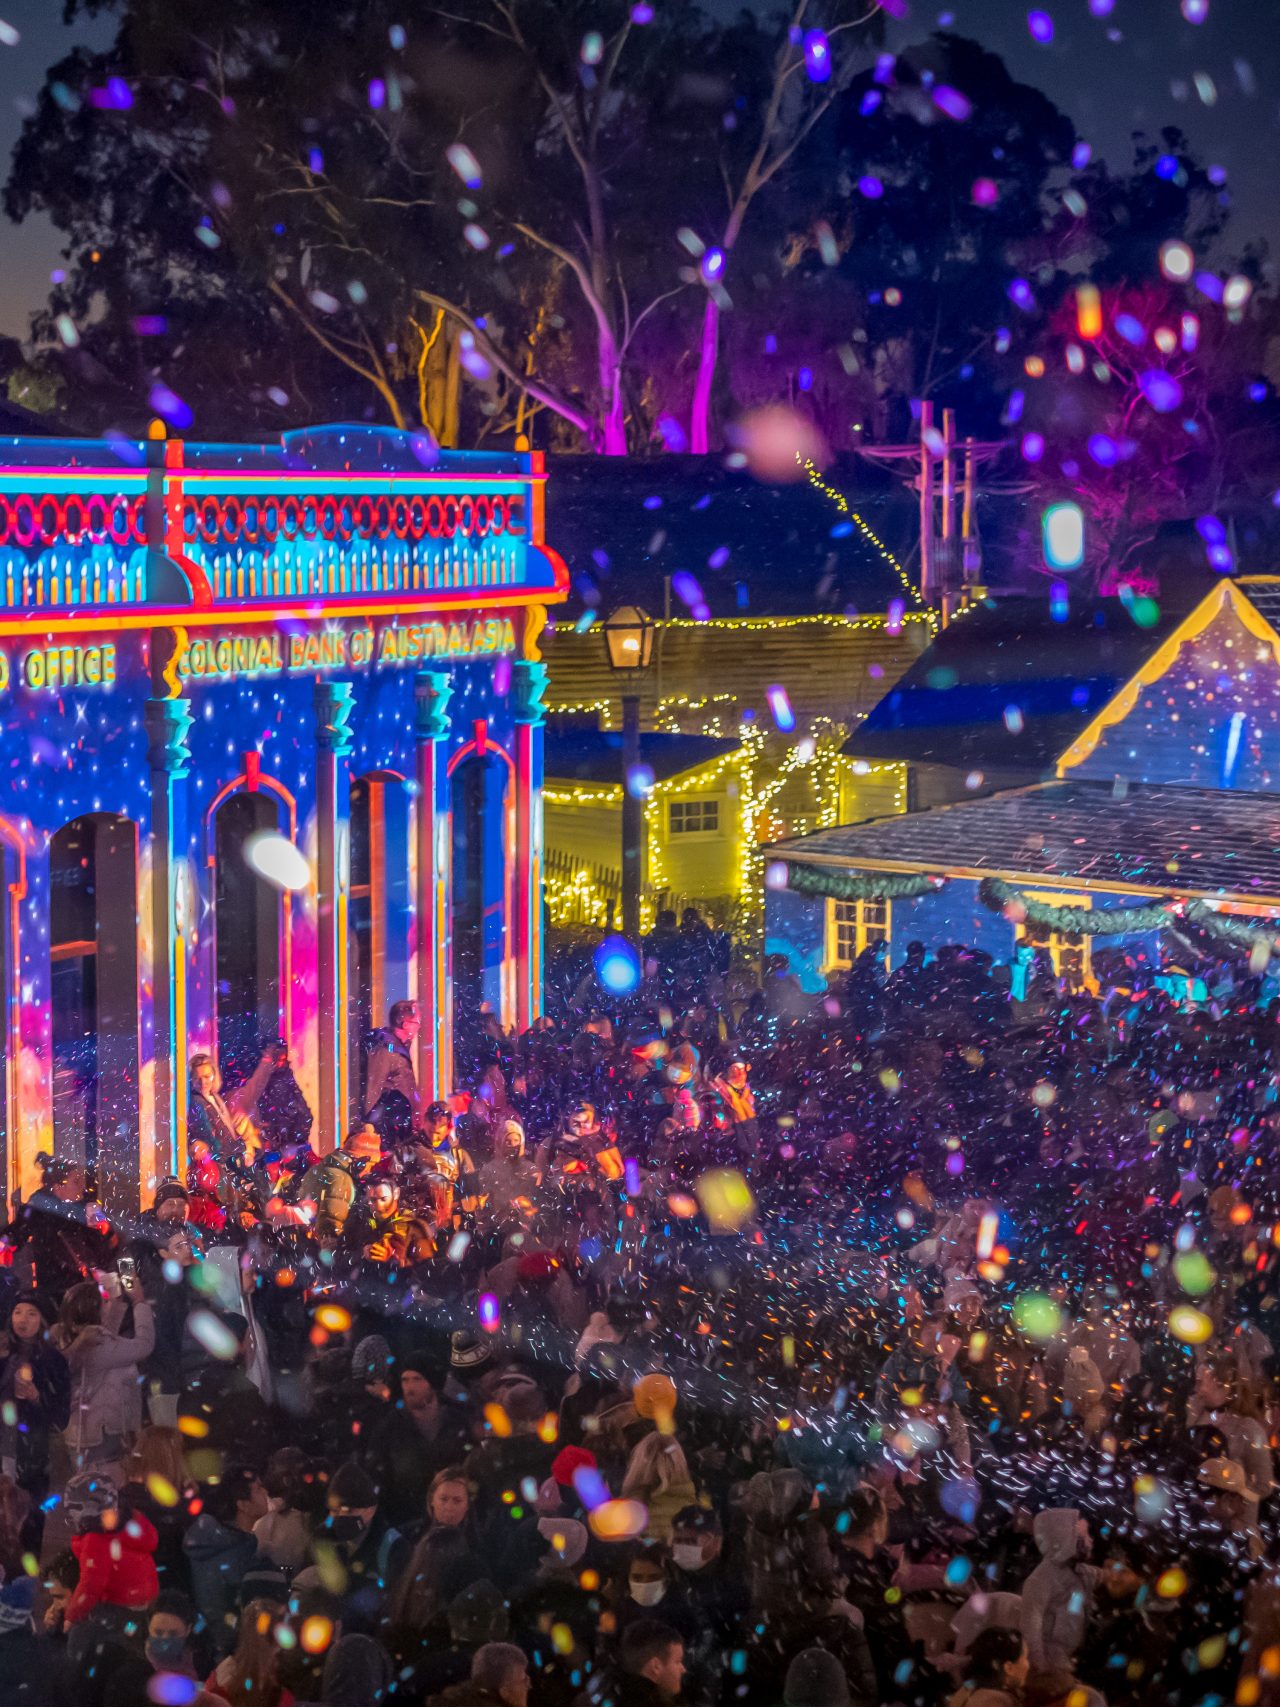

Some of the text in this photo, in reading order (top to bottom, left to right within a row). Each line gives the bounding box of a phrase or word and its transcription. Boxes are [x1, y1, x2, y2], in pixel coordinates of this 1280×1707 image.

[24, 644, 116, 690] OFFICE
[177, 618, 516, 679] COLONIAL BANK OF AUSTRALASIA
